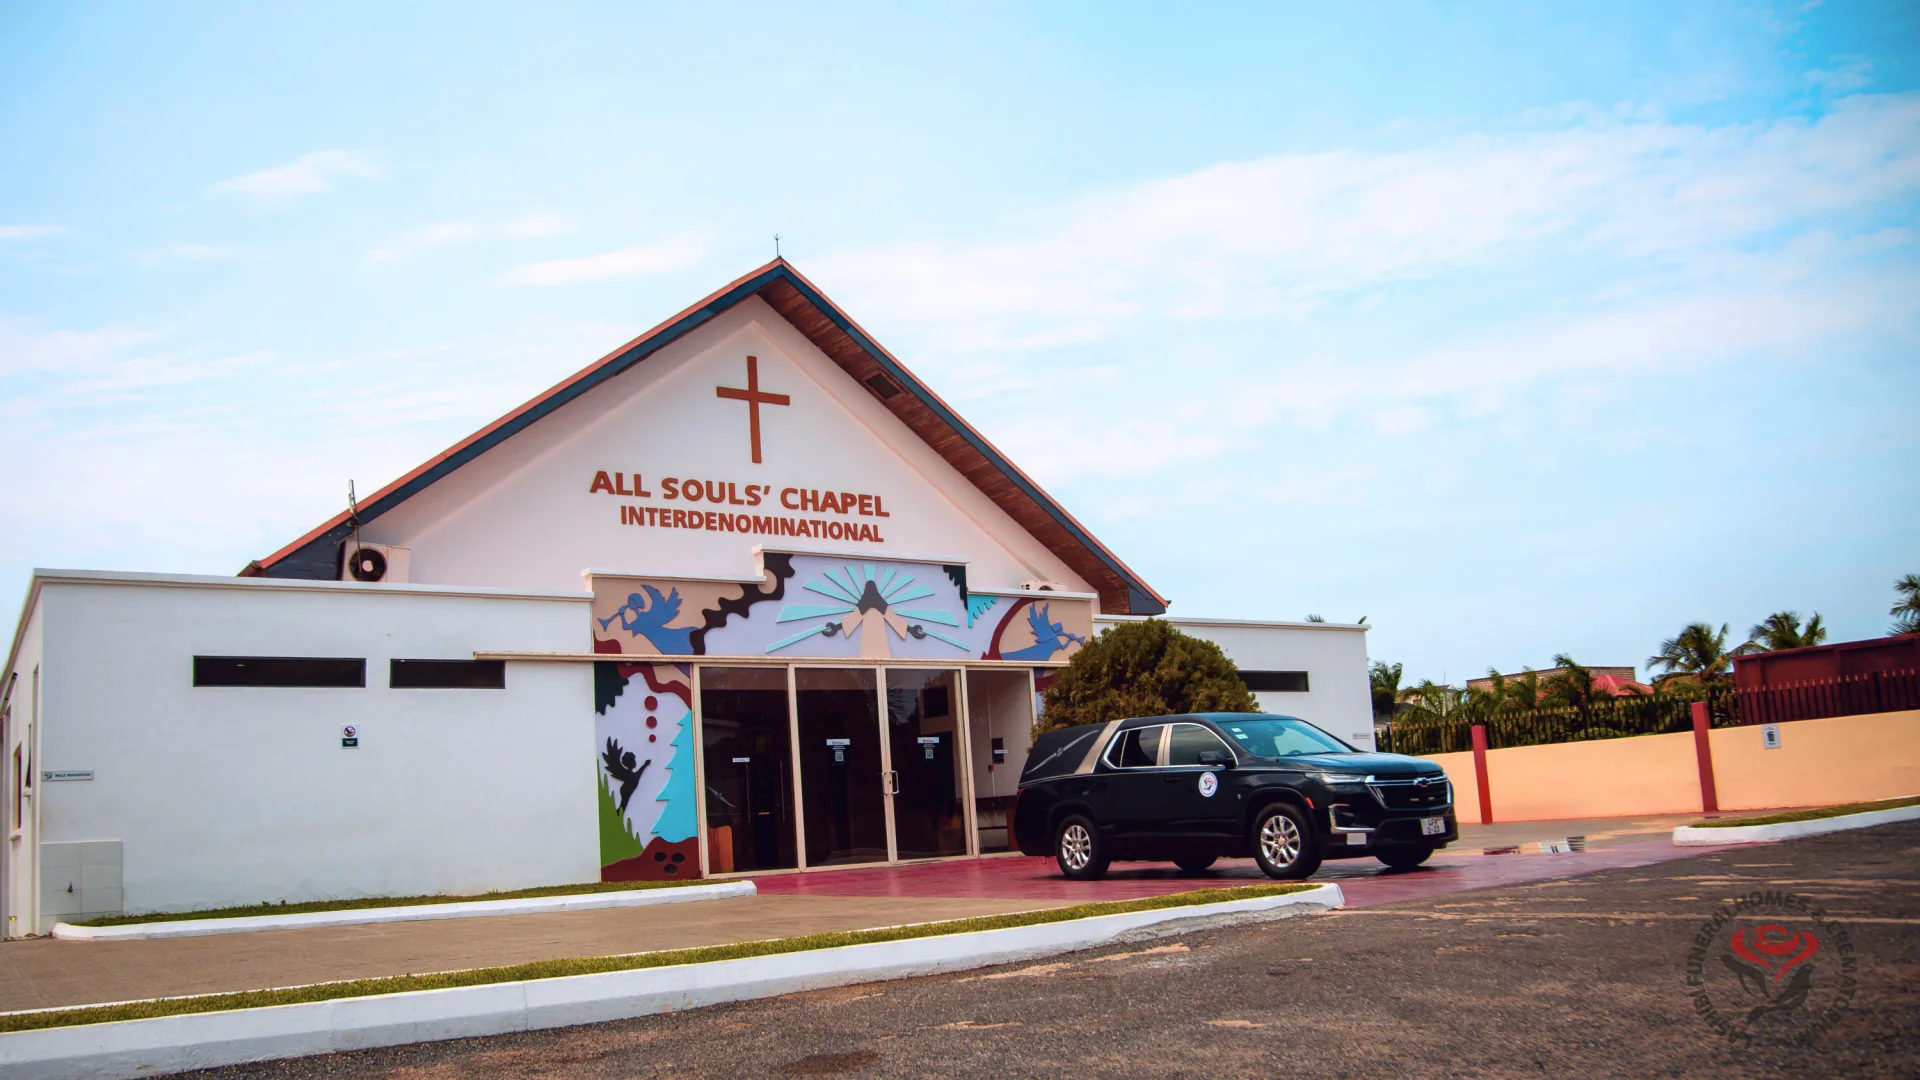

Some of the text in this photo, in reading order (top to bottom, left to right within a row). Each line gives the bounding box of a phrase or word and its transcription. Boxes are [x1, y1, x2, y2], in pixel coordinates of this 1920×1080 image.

[590, 471, 651, 497] ALL
[781, 488, 890, 517] CHAPEL
[620, 505, 885, 543] INTERDENOMINATIONAL
